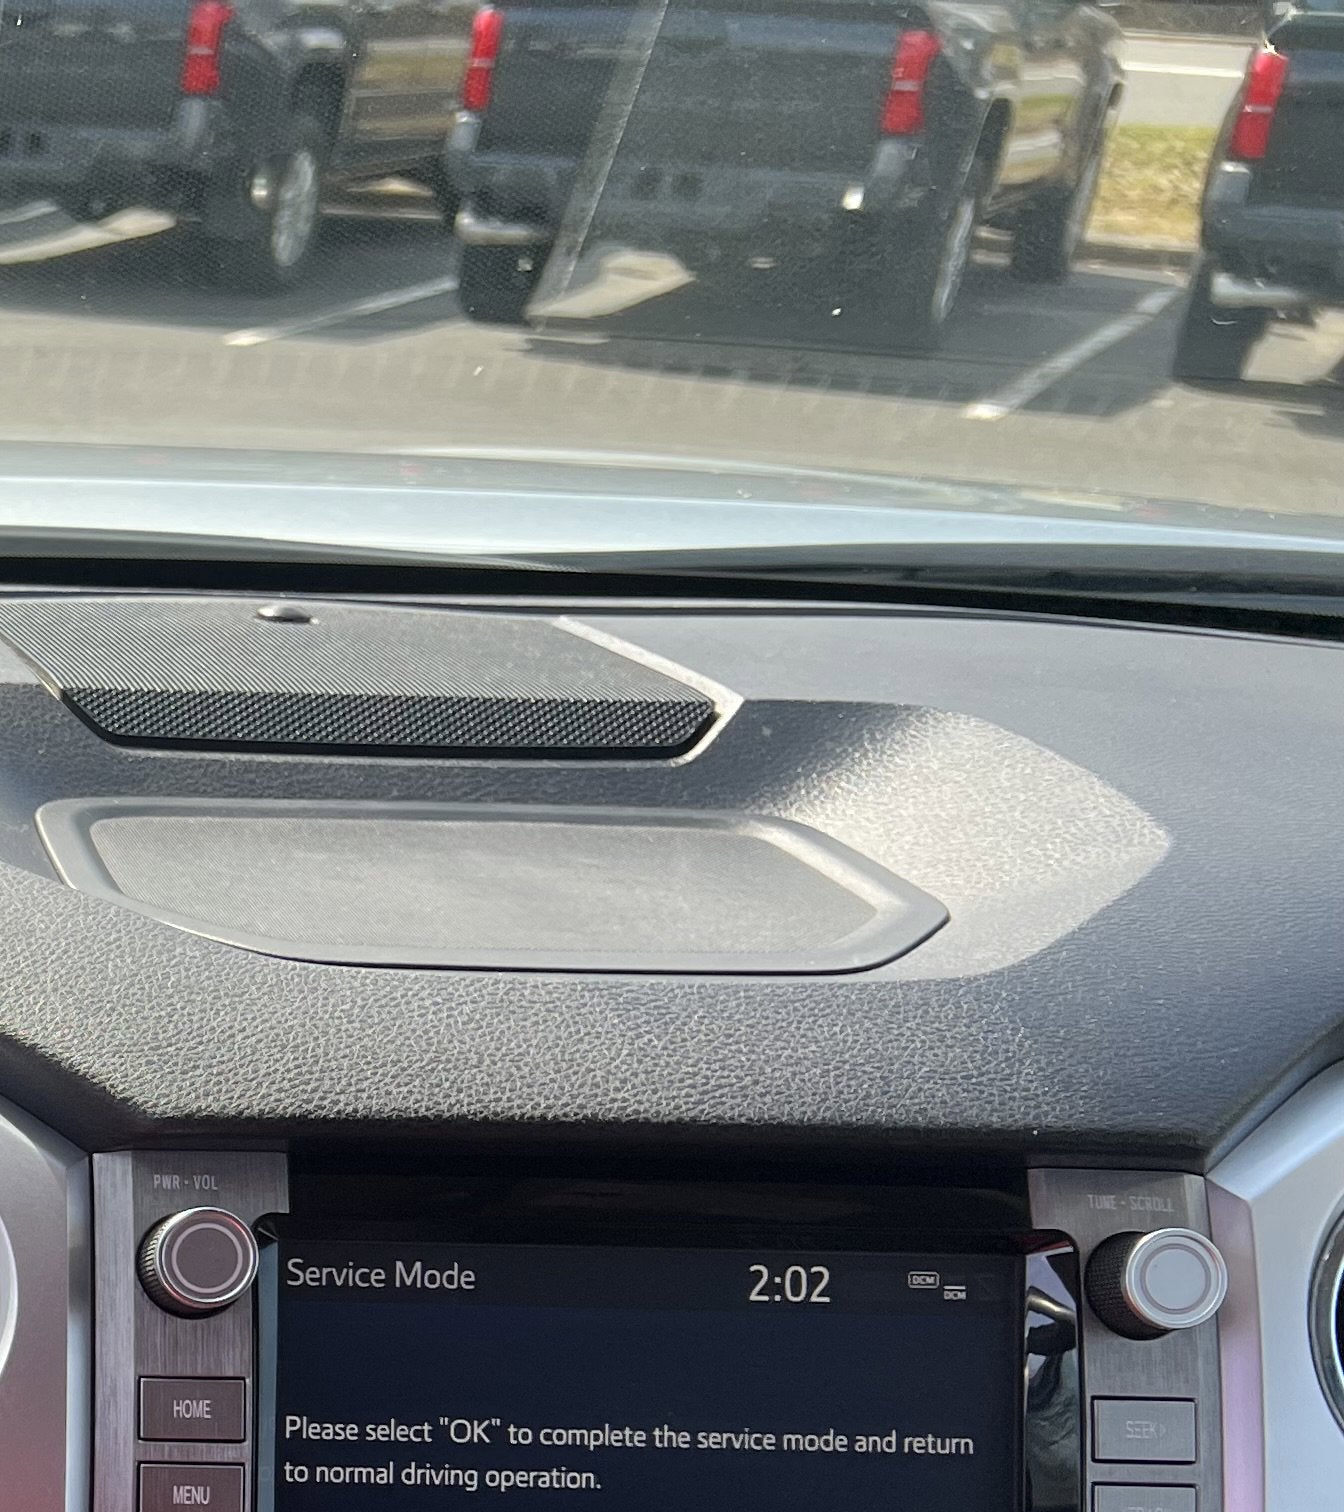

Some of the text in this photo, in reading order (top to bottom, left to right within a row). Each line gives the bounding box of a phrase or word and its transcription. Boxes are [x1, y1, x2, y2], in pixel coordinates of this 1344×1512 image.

[153, 1174, 218, 1191] PWR VOL
[285, 1258, 476, 1290] Service Mode
[748, 1263, 831, 1303] 2:02
[912, 1275, 936, 1286] DCM
[943, 1290, 967, 1301] DCM
[172, 1399, 212, 1419] HOME
[284, 1415, 974, 1455] Please select "OK" to complete the service mode and return
[284, 1461, 602, 1492] to normal driving operation.
[172, 1486, 210, 1505] MENU
